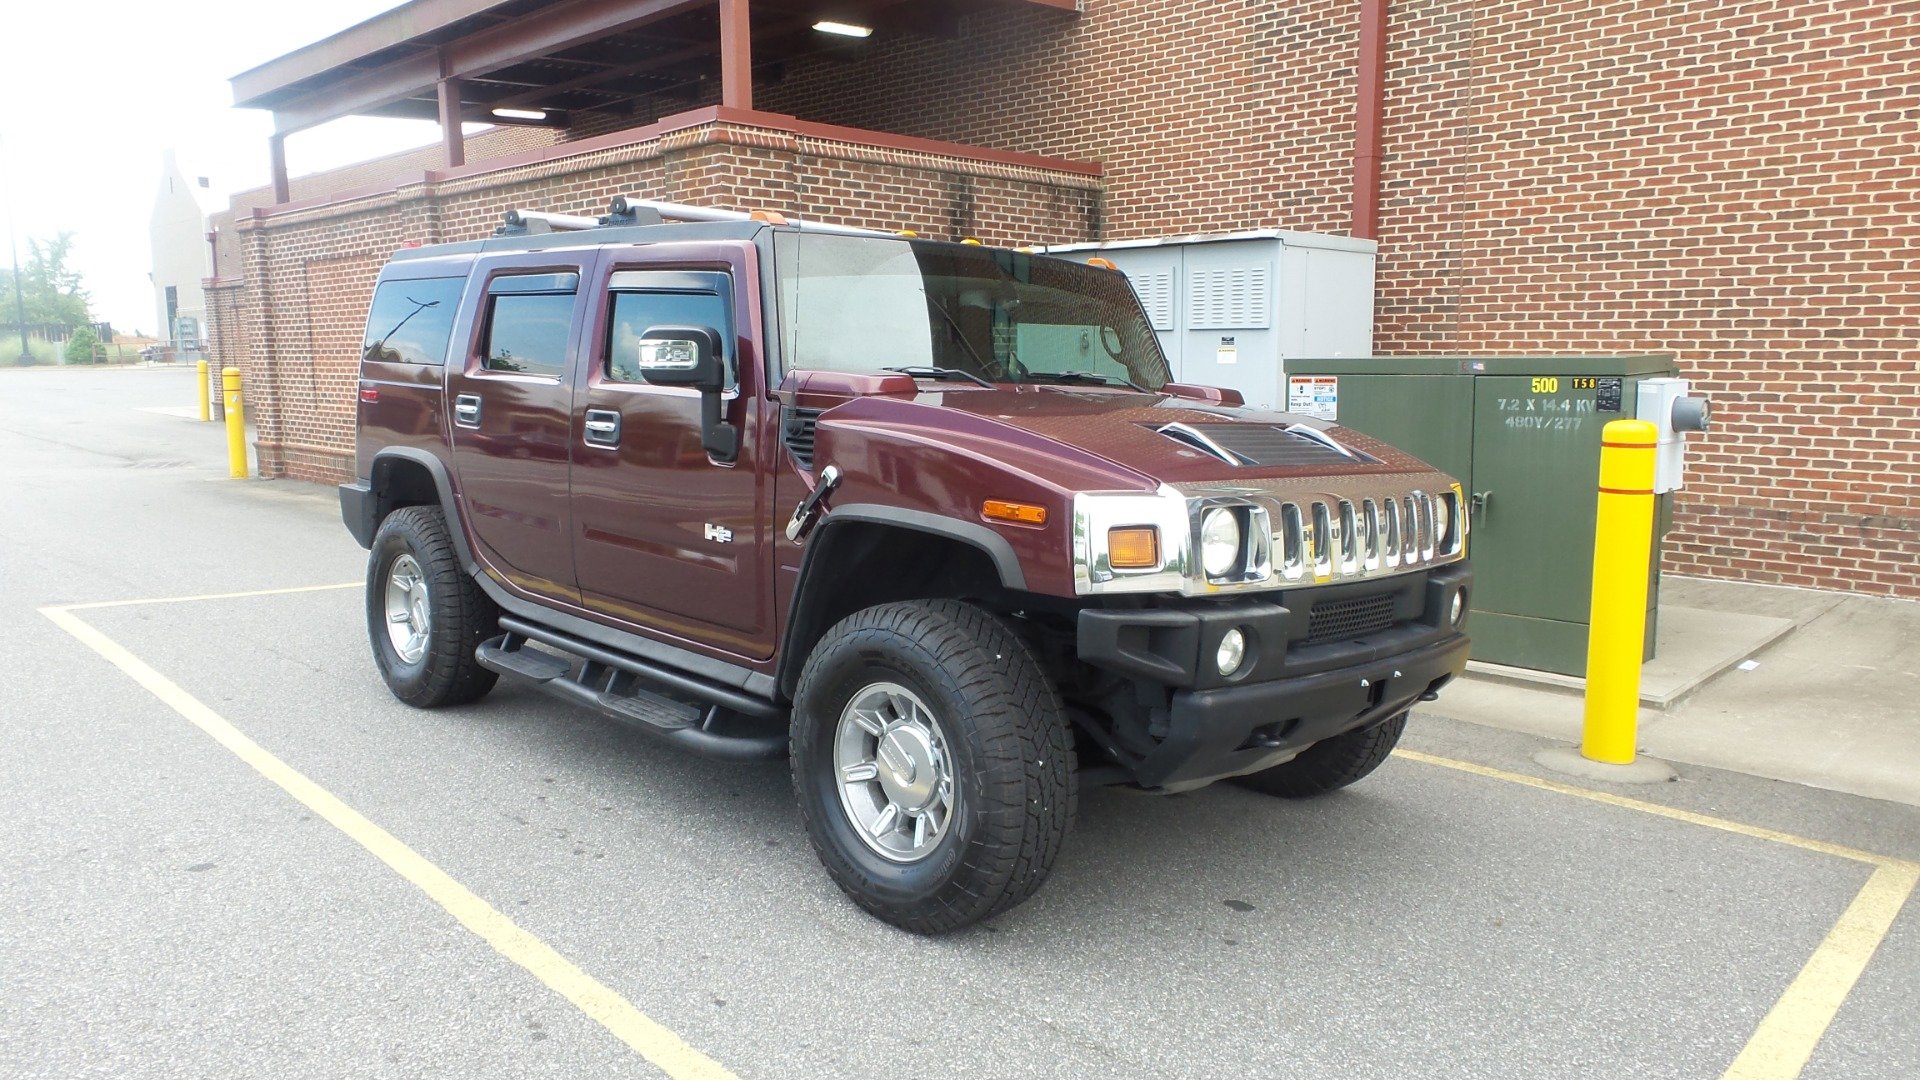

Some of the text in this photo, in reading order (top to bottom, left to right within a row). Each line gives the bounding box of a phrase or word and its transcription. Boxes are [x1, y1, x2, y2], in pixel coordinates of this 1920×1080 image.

[1531, 377, 1558, 393] 500
[1497, 399, 1596, 412] 7.2 X 14.4 KV
[704, 523, 732, 543] H2
